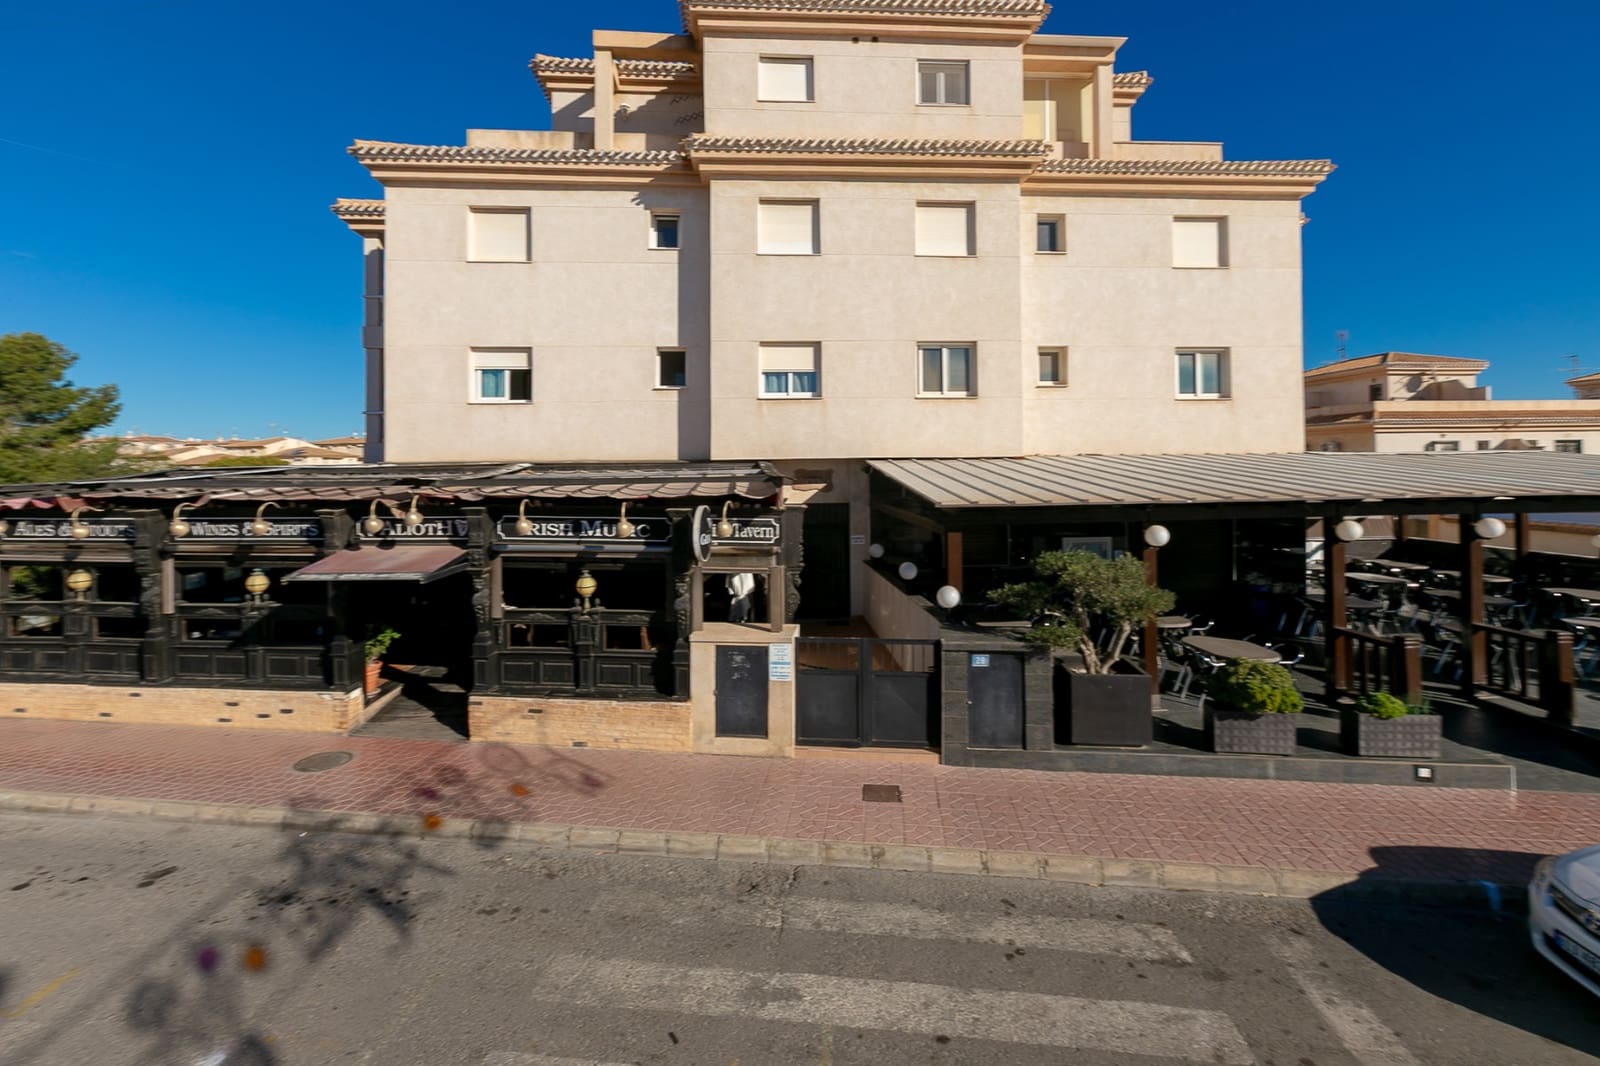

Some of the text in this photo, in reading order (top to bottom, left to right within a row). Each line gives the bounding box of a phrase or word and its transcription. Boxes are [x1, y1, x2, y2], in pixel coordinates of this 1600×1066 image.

[13, 521, 56, 536] ALES
[191, 522, 240, 536] WINES
[518, 520, 650, 538] RISH MUIC
[732, 523, 774, 538] Tavern
